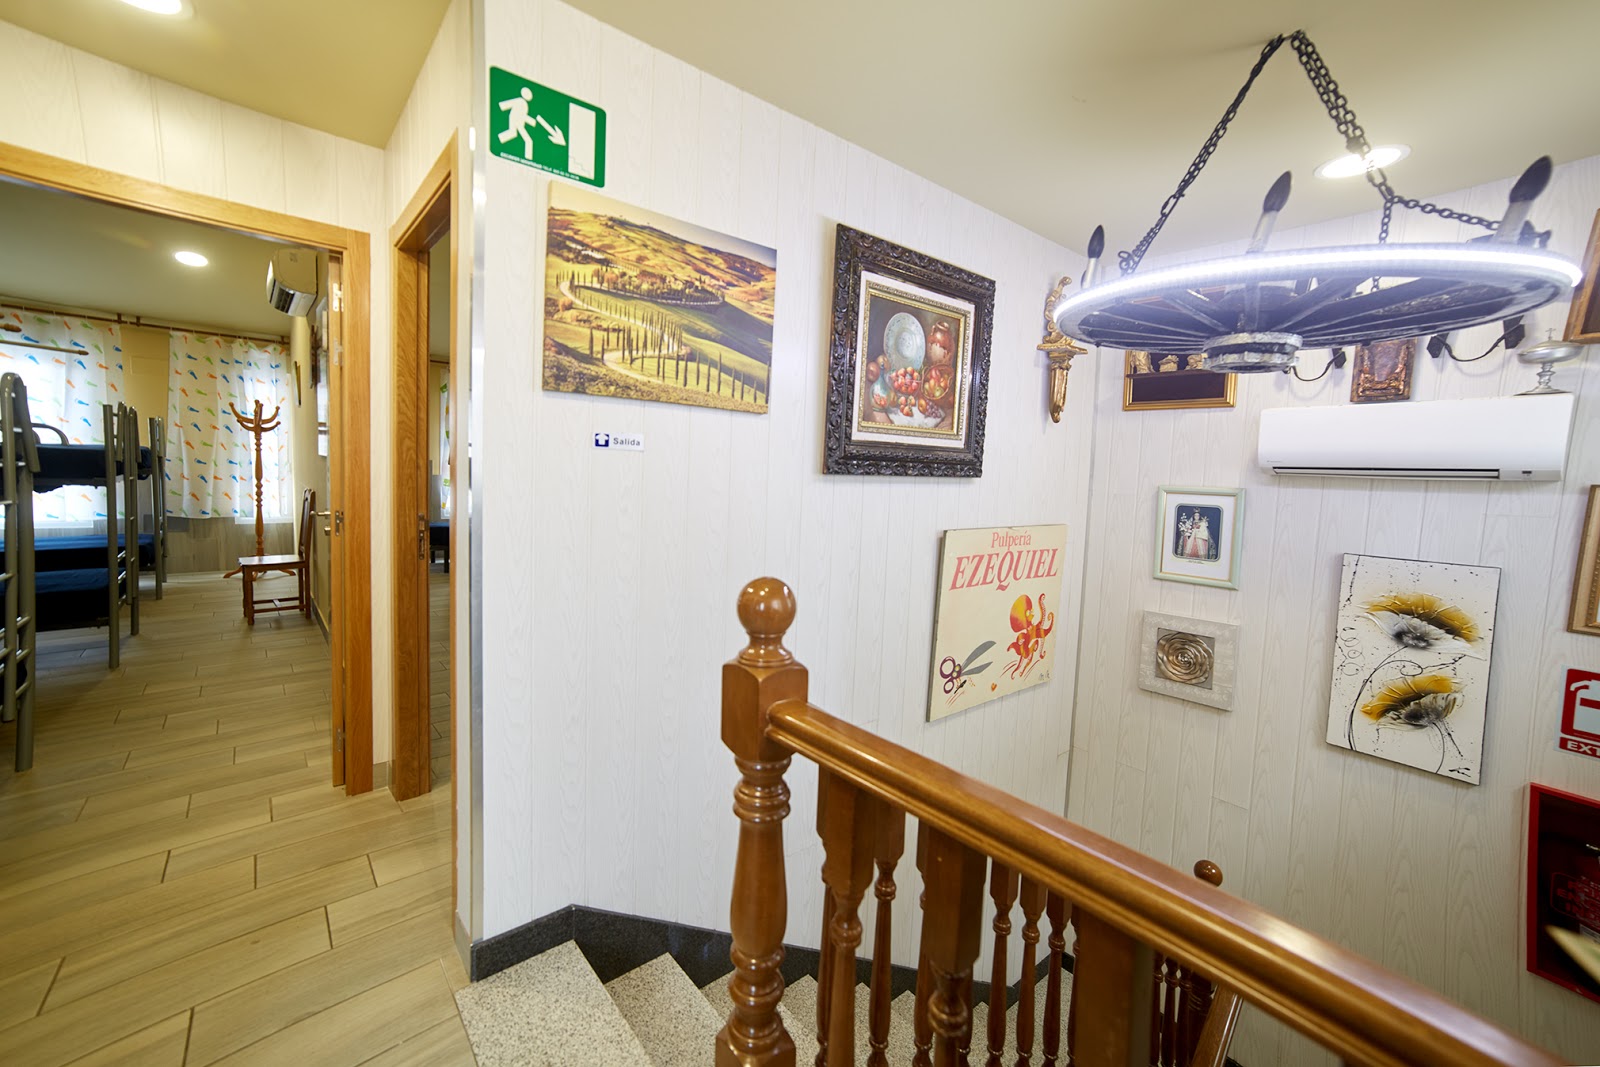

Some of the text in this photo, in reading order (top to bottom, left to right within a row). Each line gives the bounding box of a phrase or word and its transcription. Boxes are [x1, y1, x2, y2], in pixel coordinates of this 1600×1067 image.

[613, 437, 641, 446] Salida
[991, 531, 1032, 549] Pulpería
[949, 549, 1059, 591] EZEQUIEL
